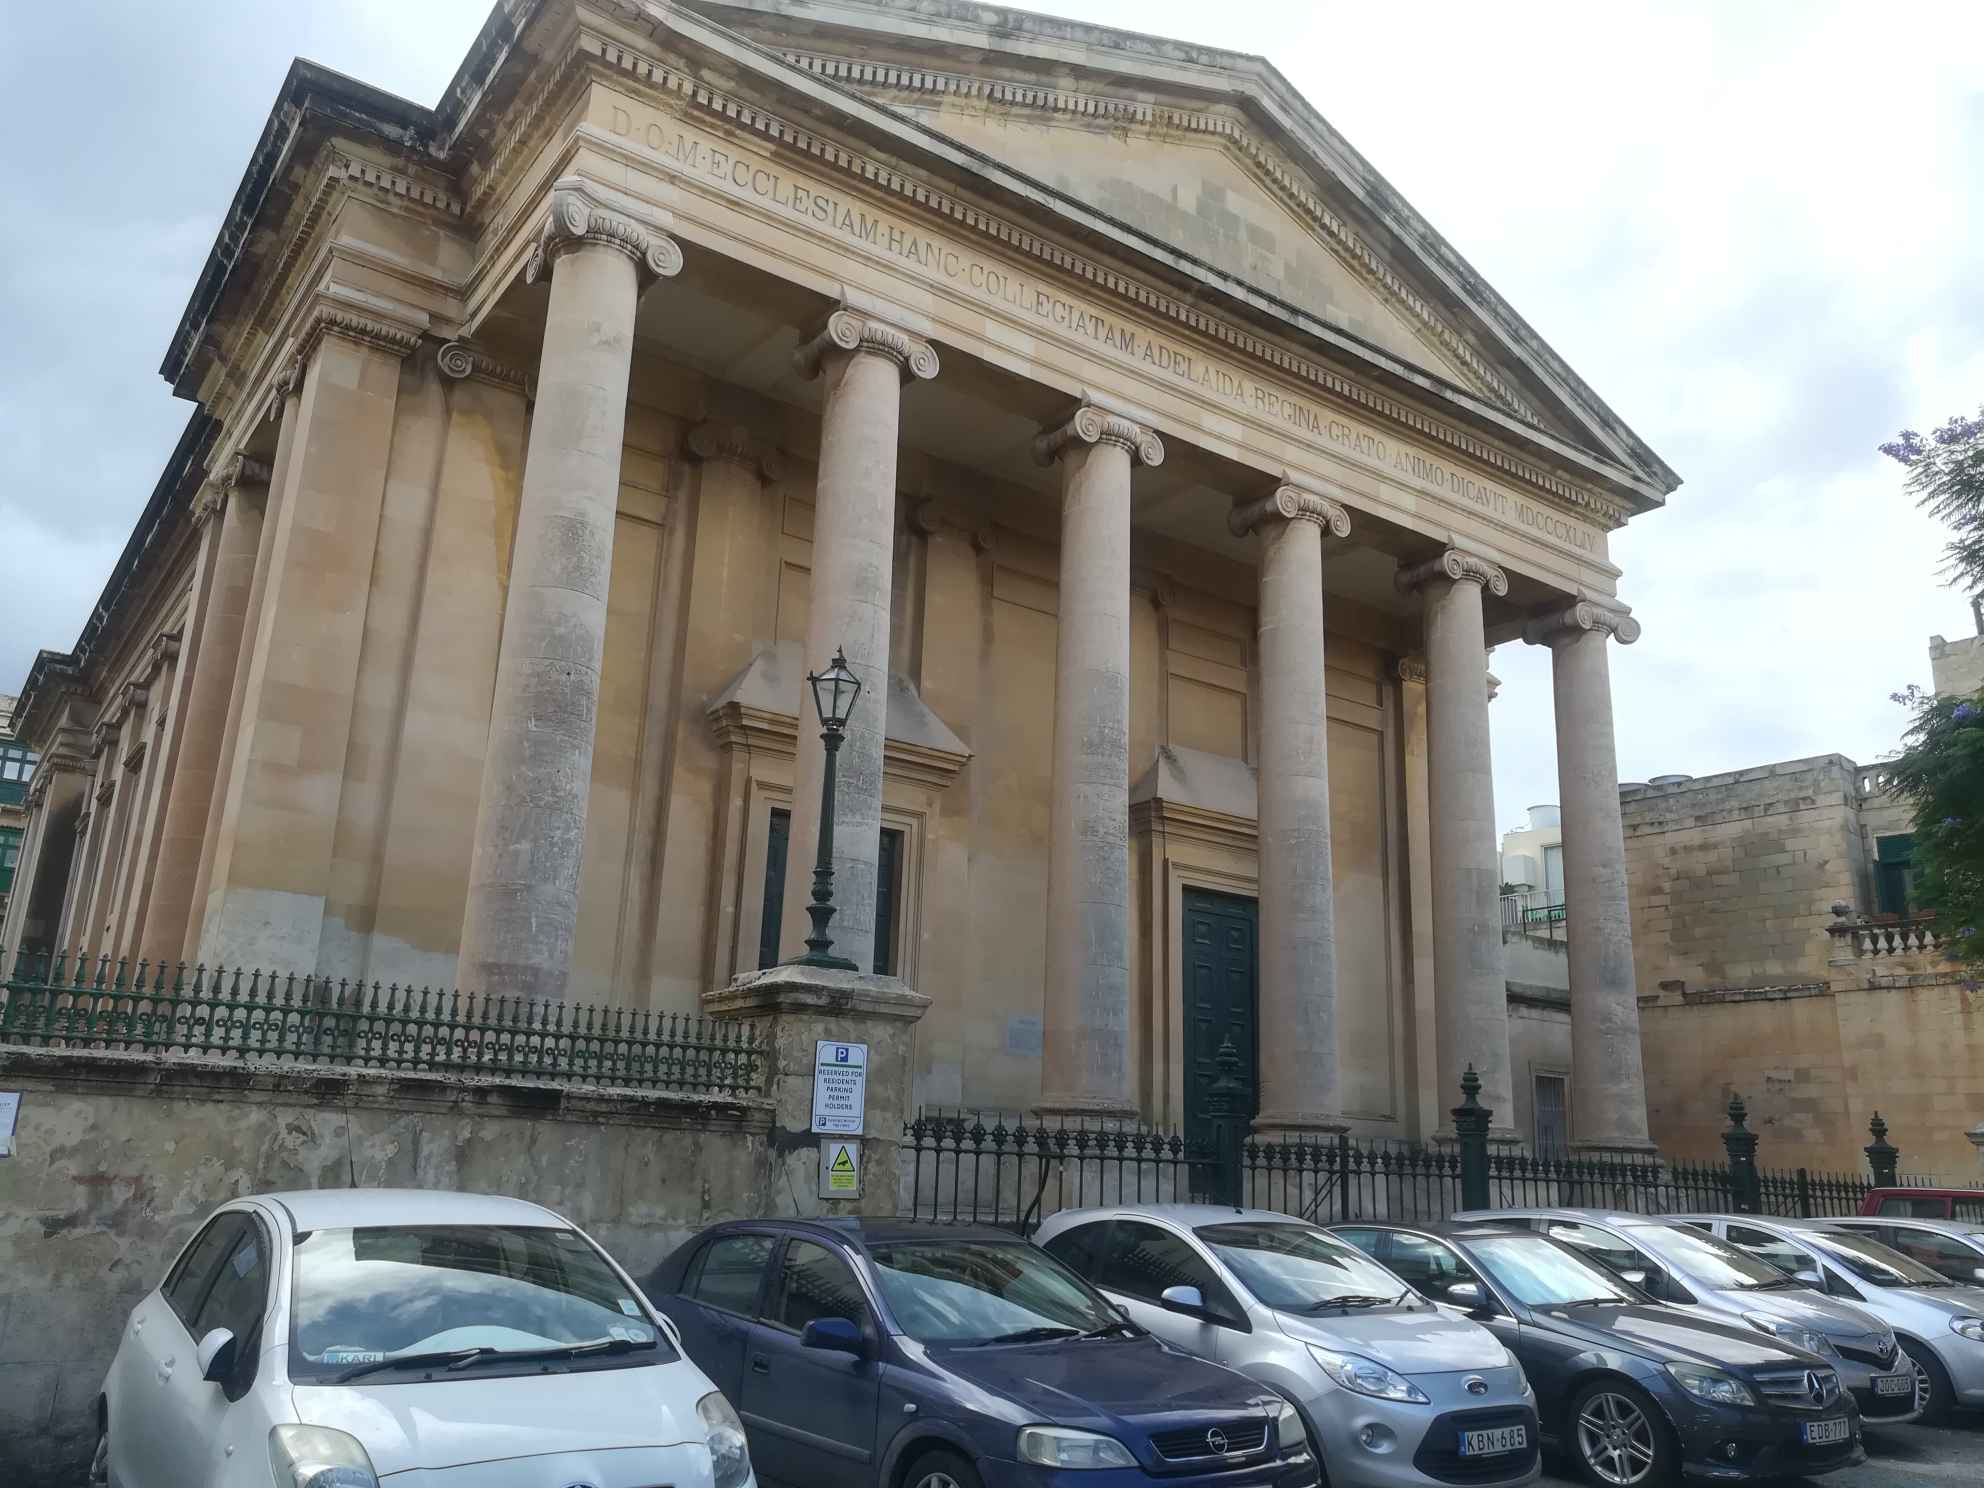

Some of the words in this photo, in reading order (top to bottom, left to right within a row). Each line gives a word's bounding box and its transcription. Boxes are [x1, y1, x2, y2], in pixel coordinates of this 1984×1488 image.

[706, 149, 880, 245] ECCLESIAM
[888, 224, 961, 278] HANC
[969, 263, 1135, 356] COLLEGIATAM
[1142, 339, 1251, 403] ADELAIDA
[1254, 386, 1322, 436] REGINA
[1328, 420, 1386, 460] GRATO
[1393, 452, 1444, 487] ANIMO
[1449, 473, 1508, 515] DICAVIT
[818, 1068, 850, 1077] RESERVED
[823, 1078, 857, 1086] RESIDENTS
[826, 1086, 853, 1094] PARKING
[825, 1103, 853, 1111] HOLDERS
